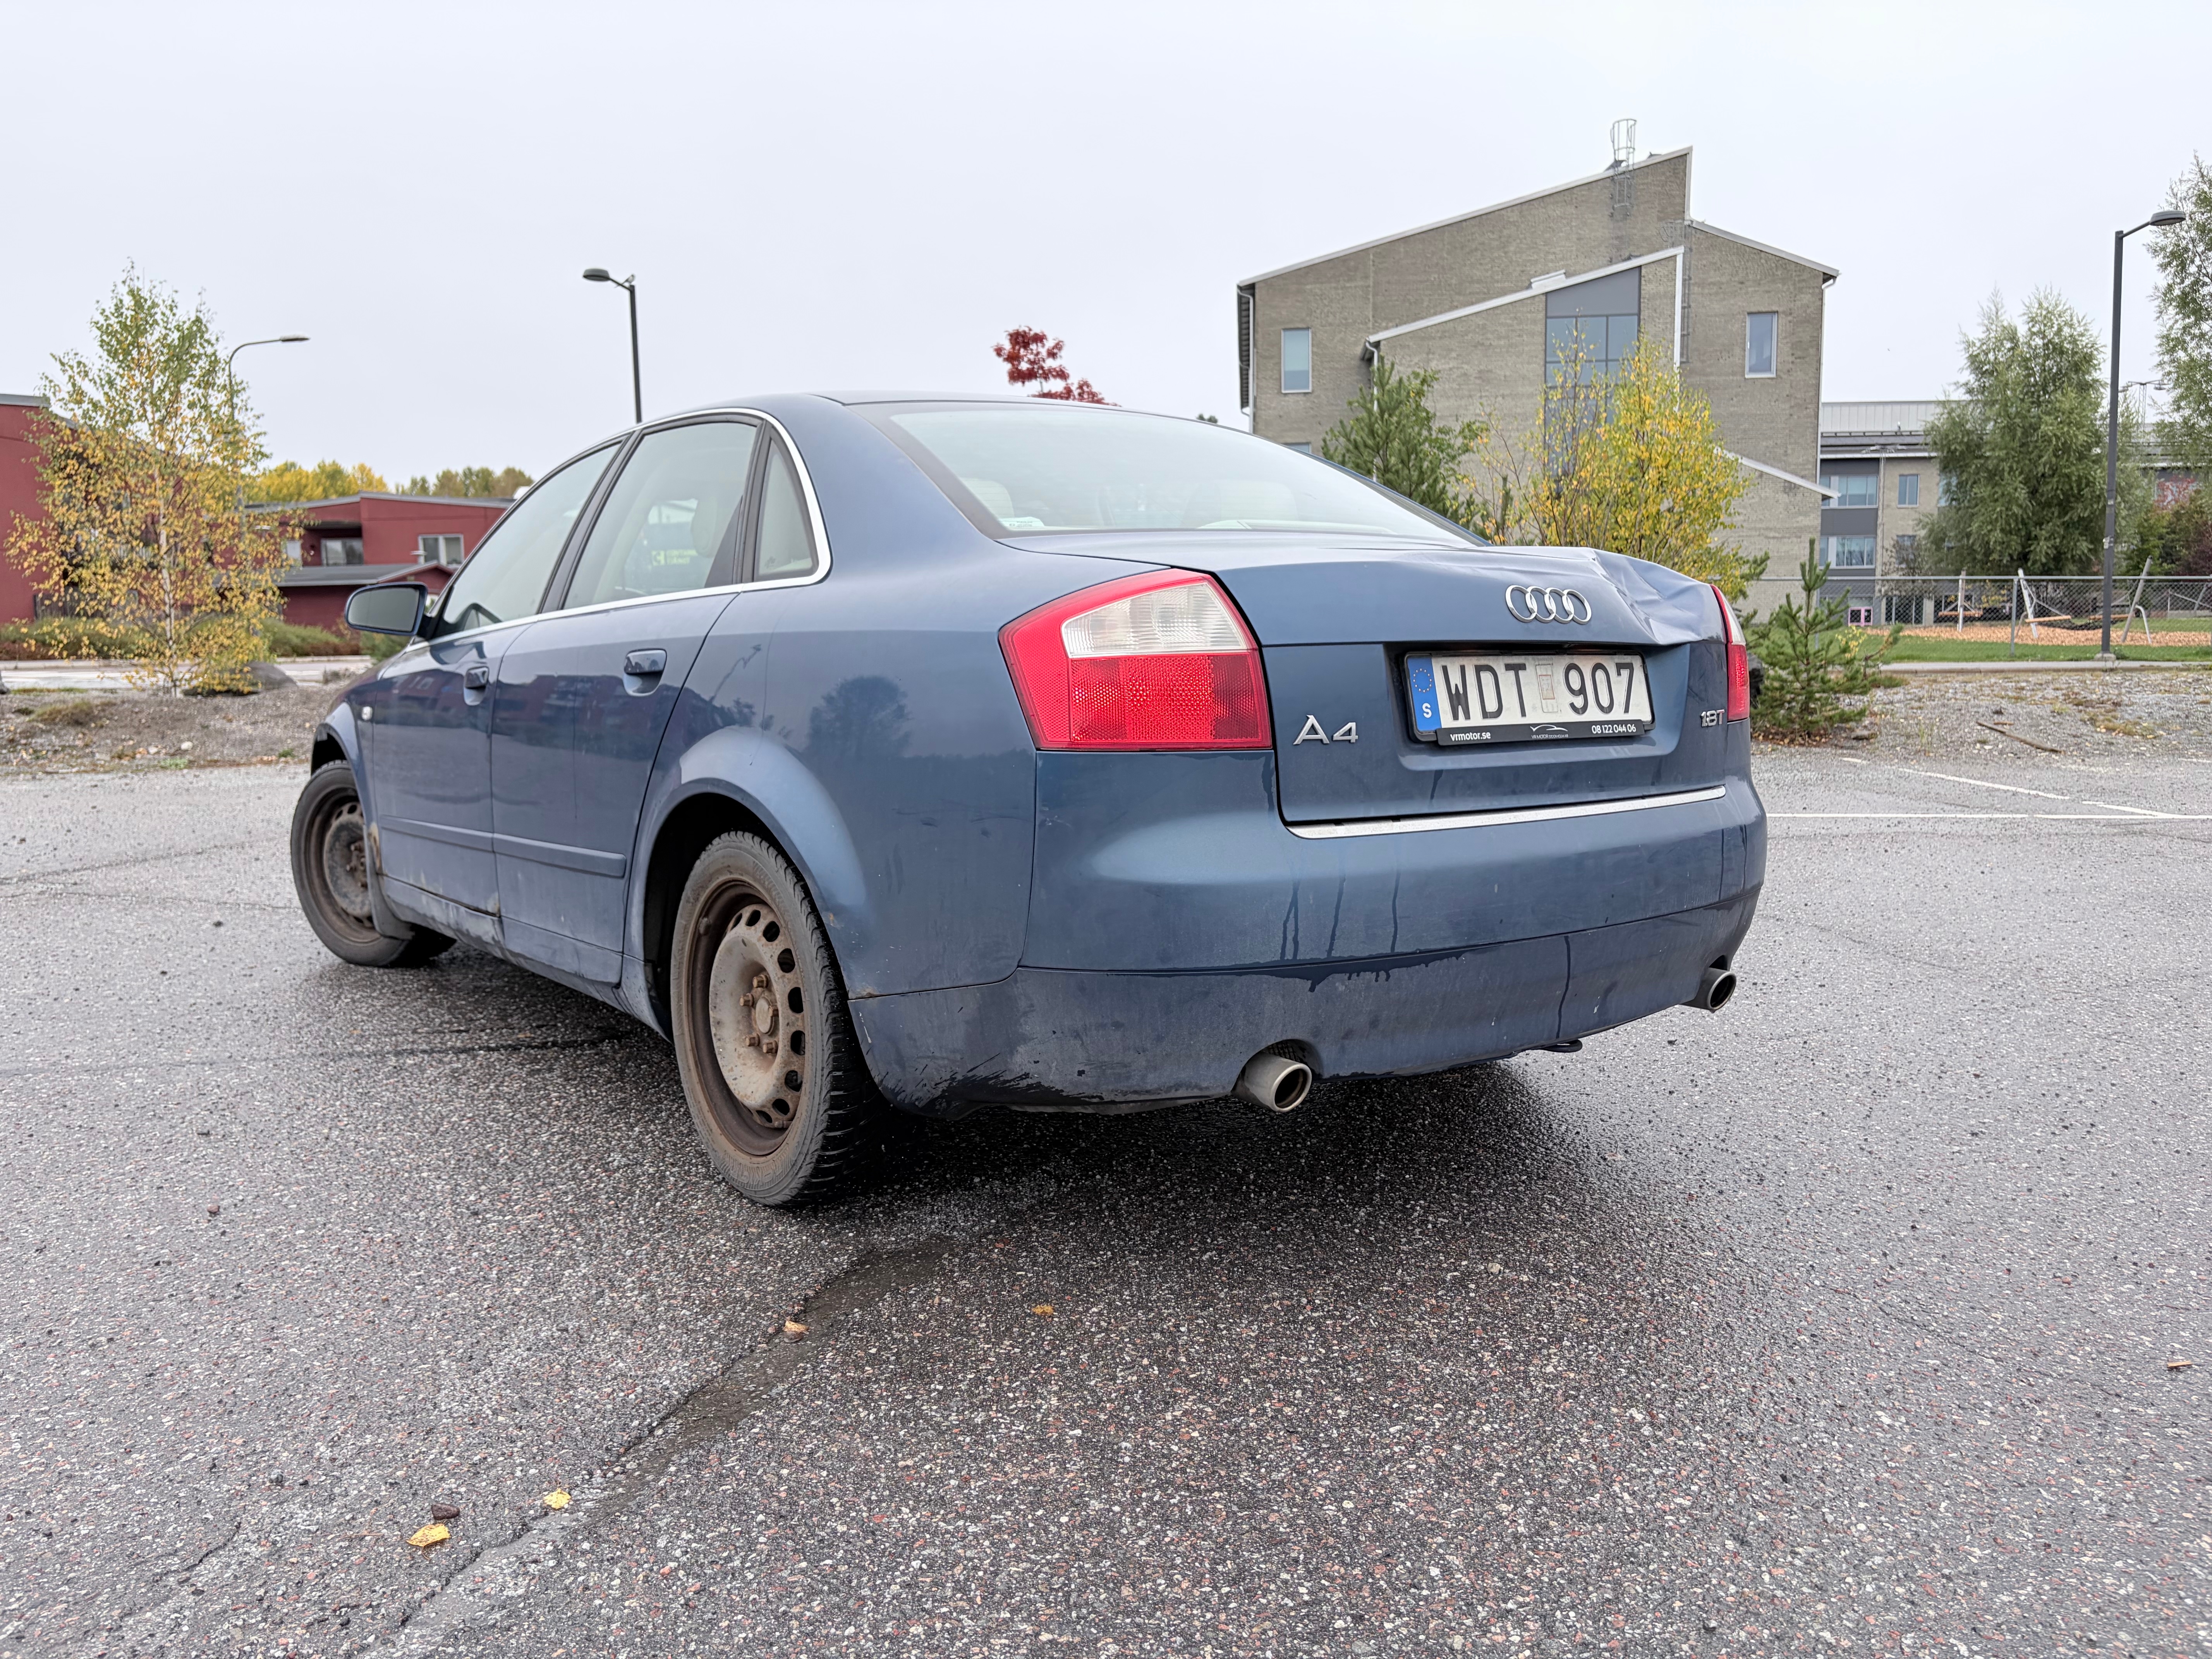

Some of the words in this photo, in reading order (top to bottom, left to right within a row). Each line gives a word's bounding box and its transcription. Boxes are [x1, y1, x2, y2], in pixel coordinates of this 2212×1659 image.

[1441, 663, 1527, 721] WDT
[1564, 662, 1634, 714] 907
[1422, 703, 1432, 718] S
[1293, 714, 1358, 745] A4
[1450, 732, 1491, 741] vrmotor.se
[1592, 725, 1602, 734] 08
[1602, 725, 1613, 733] 122
[1613, 724, 1626, 733] 044
[1627, 724, 1637, 732] 06
